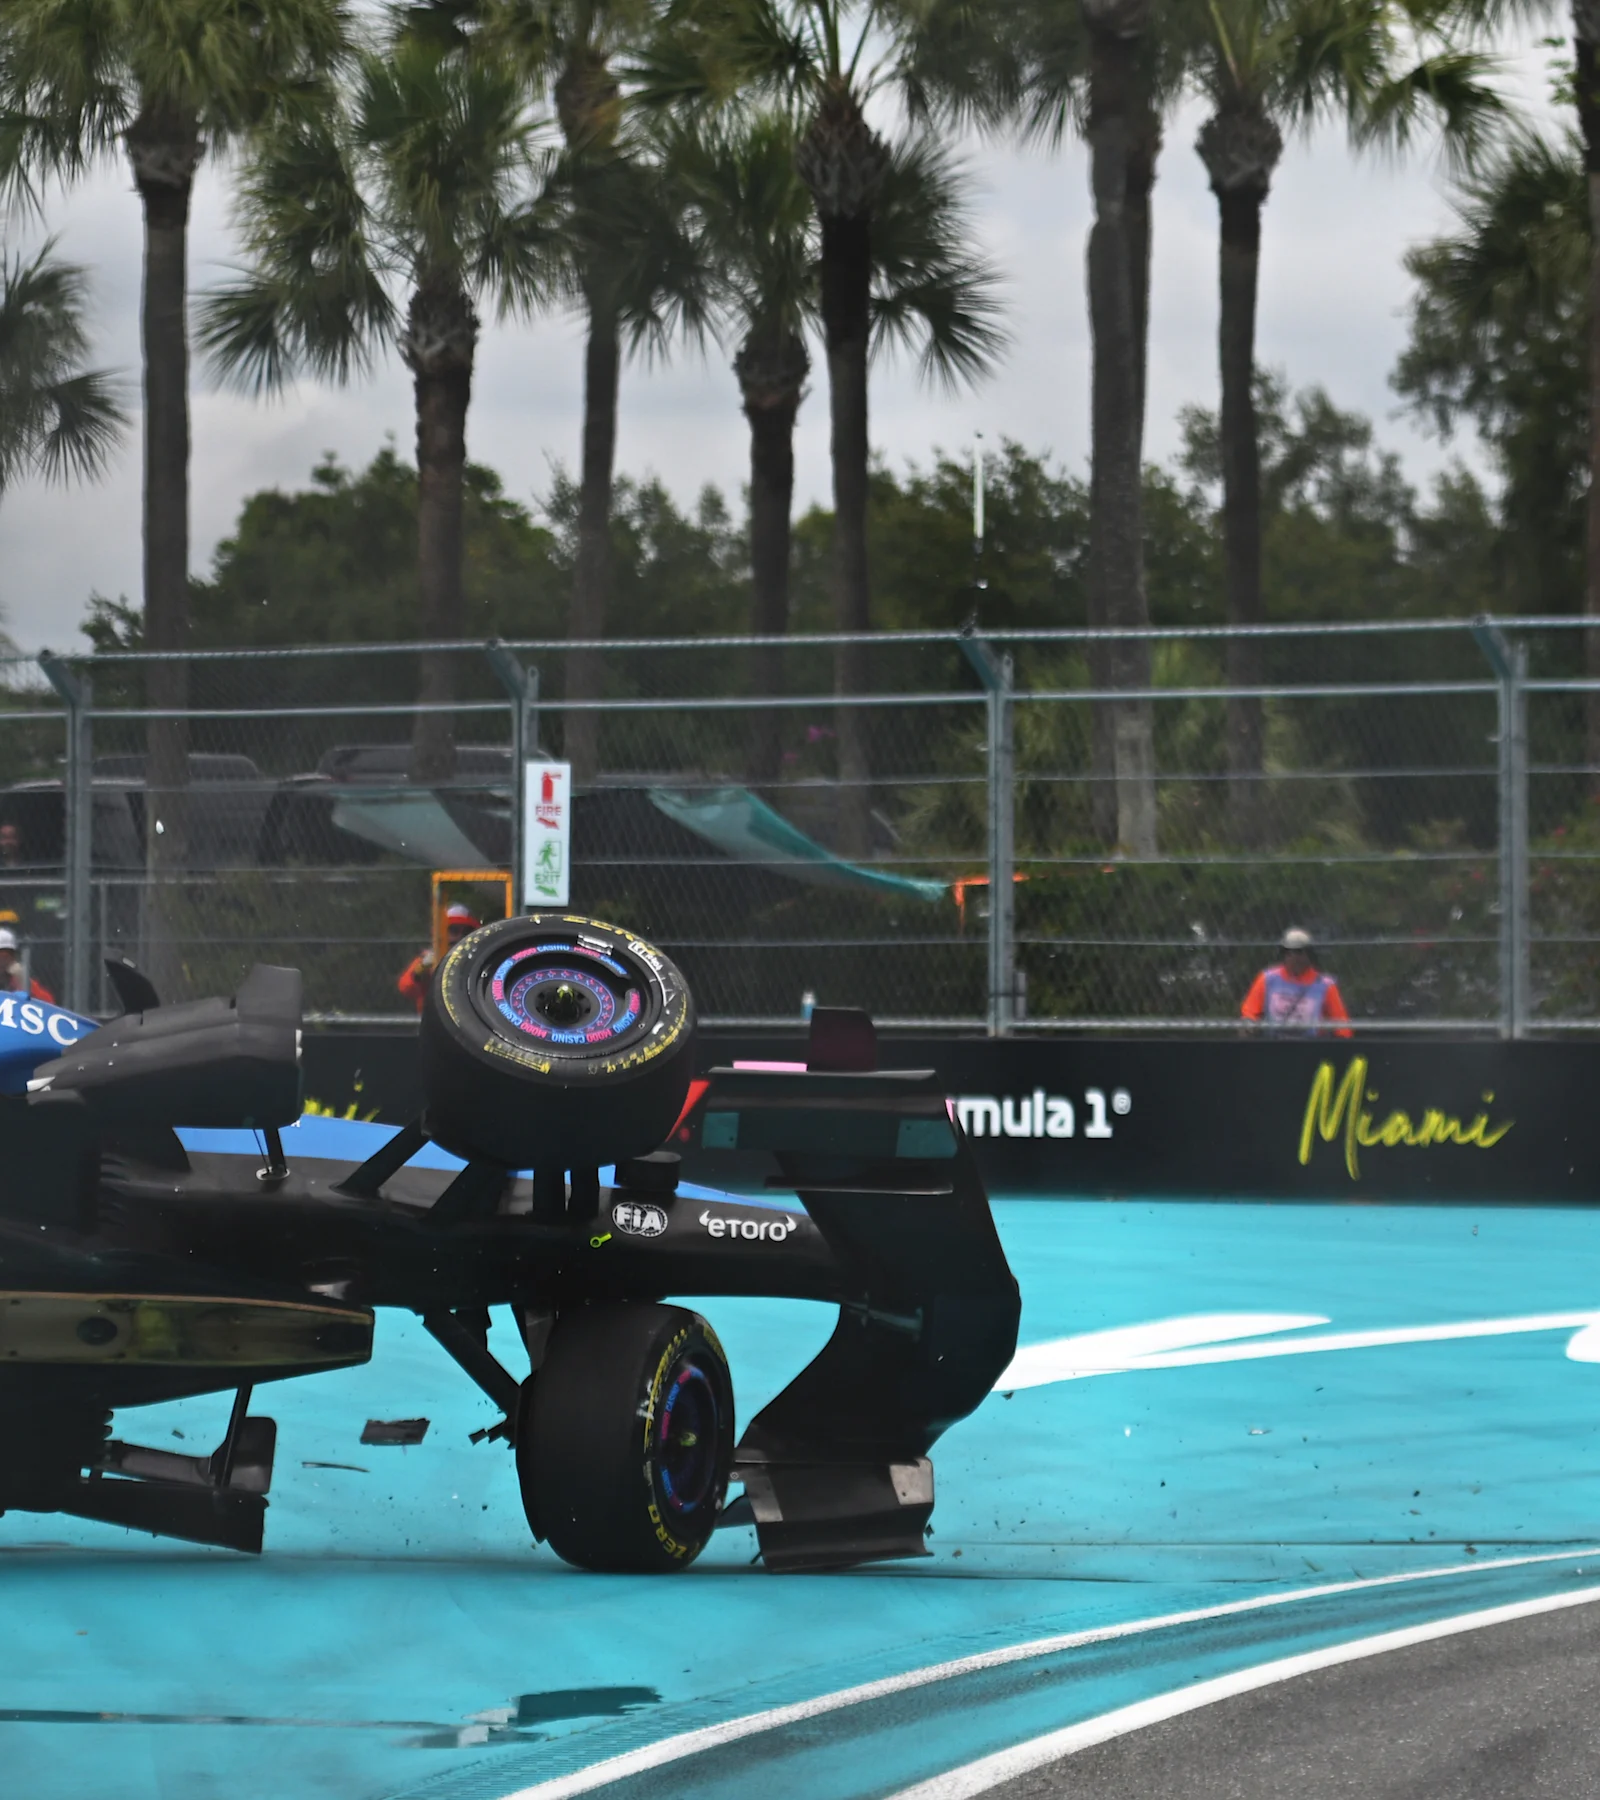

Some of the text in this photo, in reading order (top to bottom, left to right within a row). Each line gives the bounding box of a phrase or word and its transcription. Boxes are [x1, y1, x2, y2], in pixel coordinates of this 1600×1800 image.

[535, 805, 562, 817] FIRE
[534, 873, 561, 885] EXIT
[499, 1002, 522, 1027] CASINO
[551, 1032, 586, 1044] CASINO
[953, 1087, 1076, 1138] mula
[1298, 1056, 1516, 1180] Miami
